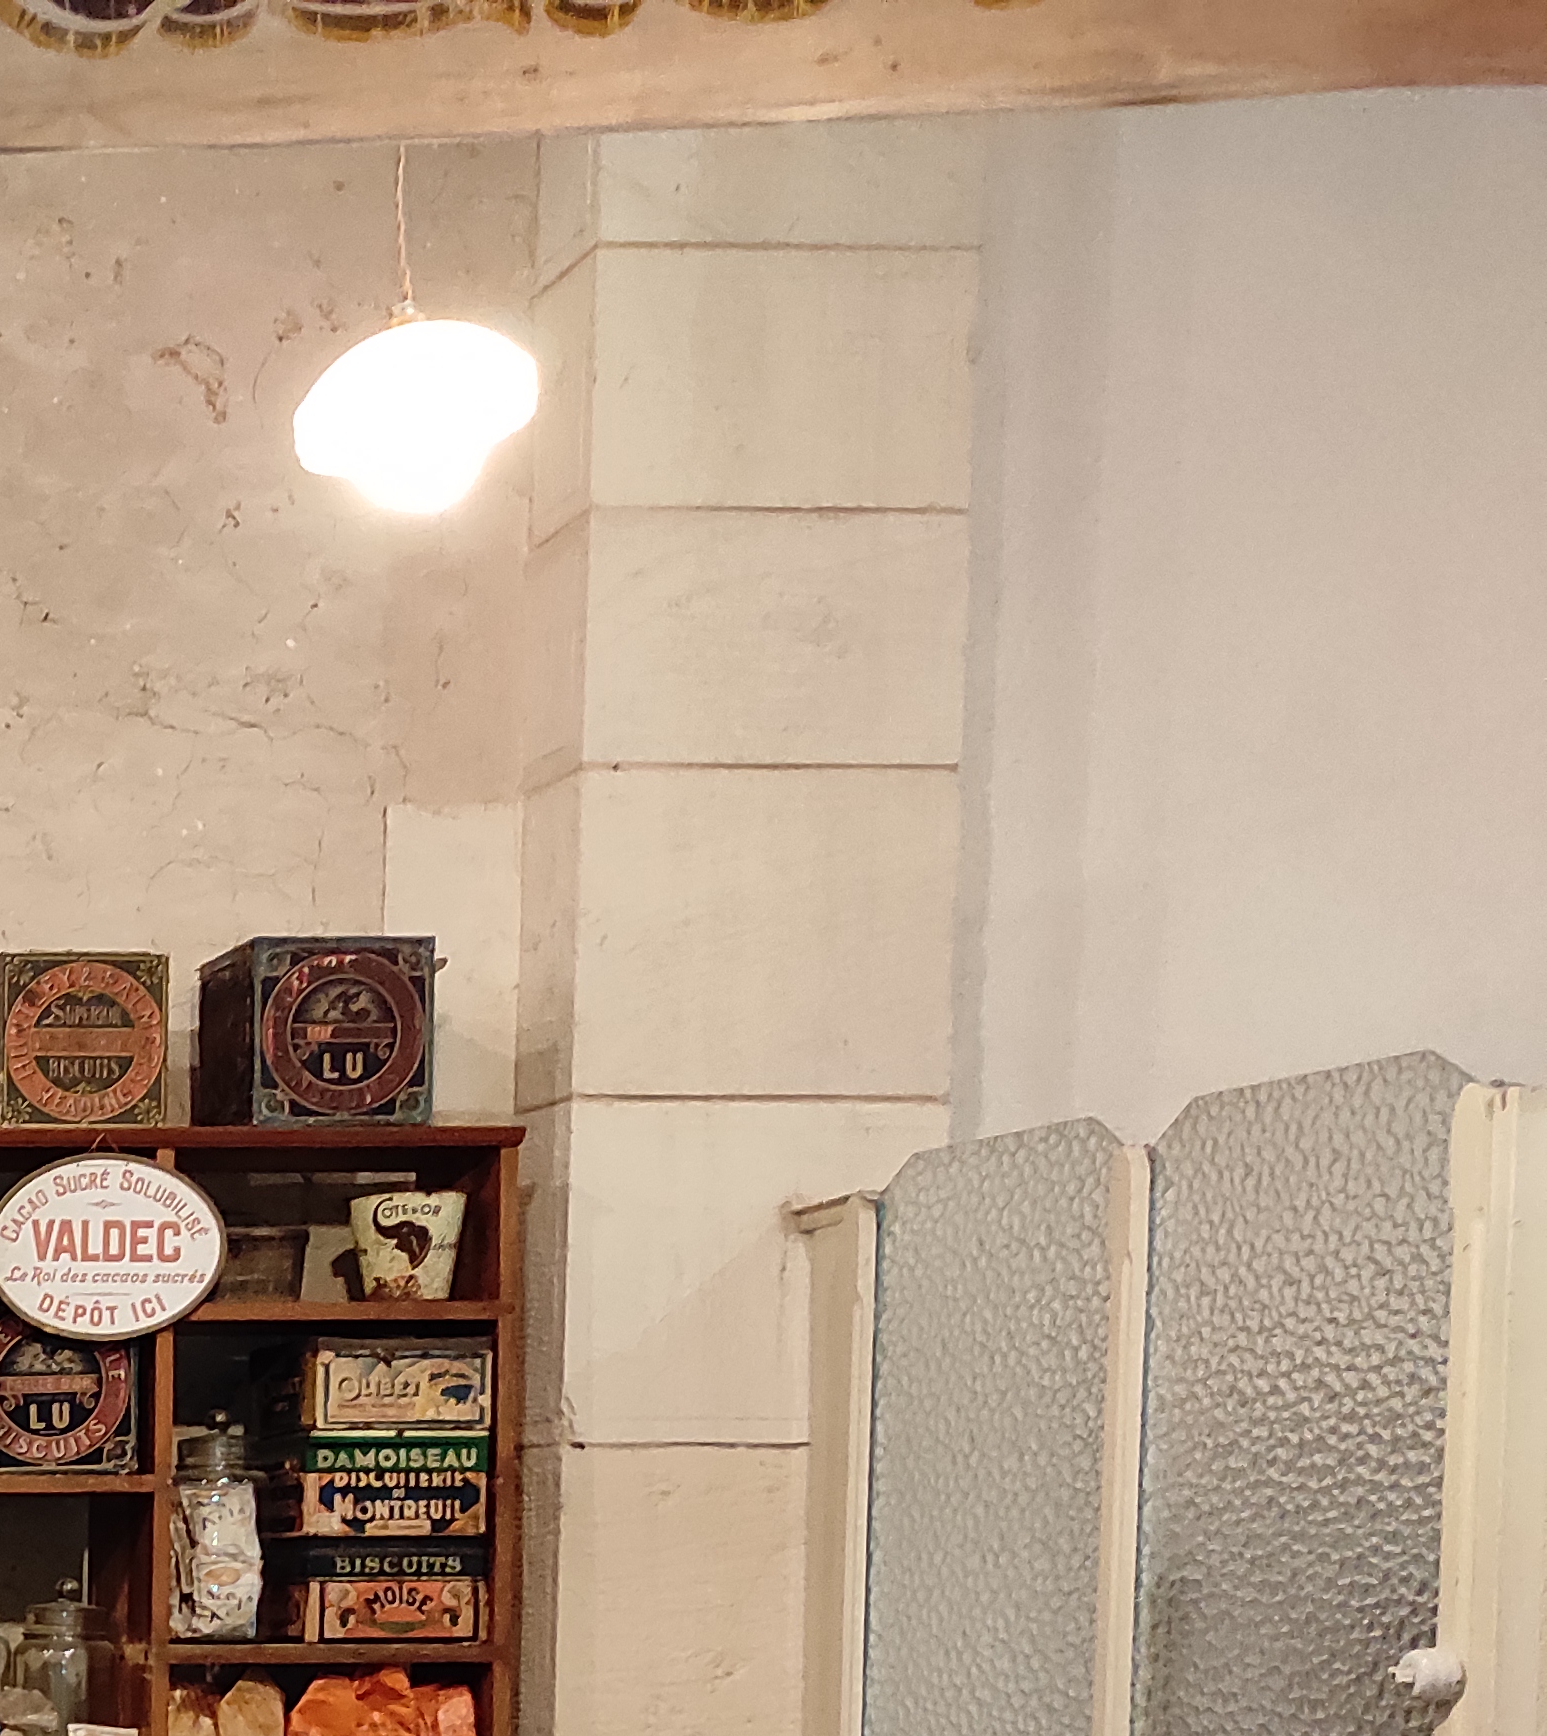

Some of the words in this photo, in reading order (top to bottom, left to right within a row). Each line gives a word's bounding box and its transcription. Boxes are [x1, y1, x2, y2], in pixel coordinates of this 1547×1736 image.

[48, 1057, 120, 1079] BISCUITS
[322, 1051, 364, 1080] LU
[52, 1167, 111, 1198] SUCRÉ
[119, 1166, 212, 1243] SOLUBILISÉ
[30, 1218, 183, 1264] VALDEC
[4, 1265, 28, 1284] Le
[60, 1266, 88, 1285] des
[91, 1271, 149, 1285] cacaos
[151, 1268, 208, 1285] sucrés
[36, 1292, 120, 1329] DÉPÔT
[130, 1291, 169, 1324] ICI
[337, 1376, 422, 1401] OLIBET
[28, 1402, 72, 1431] LU
[316, 1447, 479, 1470] DAMOISEAU
[333, 1493, 464, 1521] MONTREUIL
[335, 1556, 463, 1574] BISCUITS
